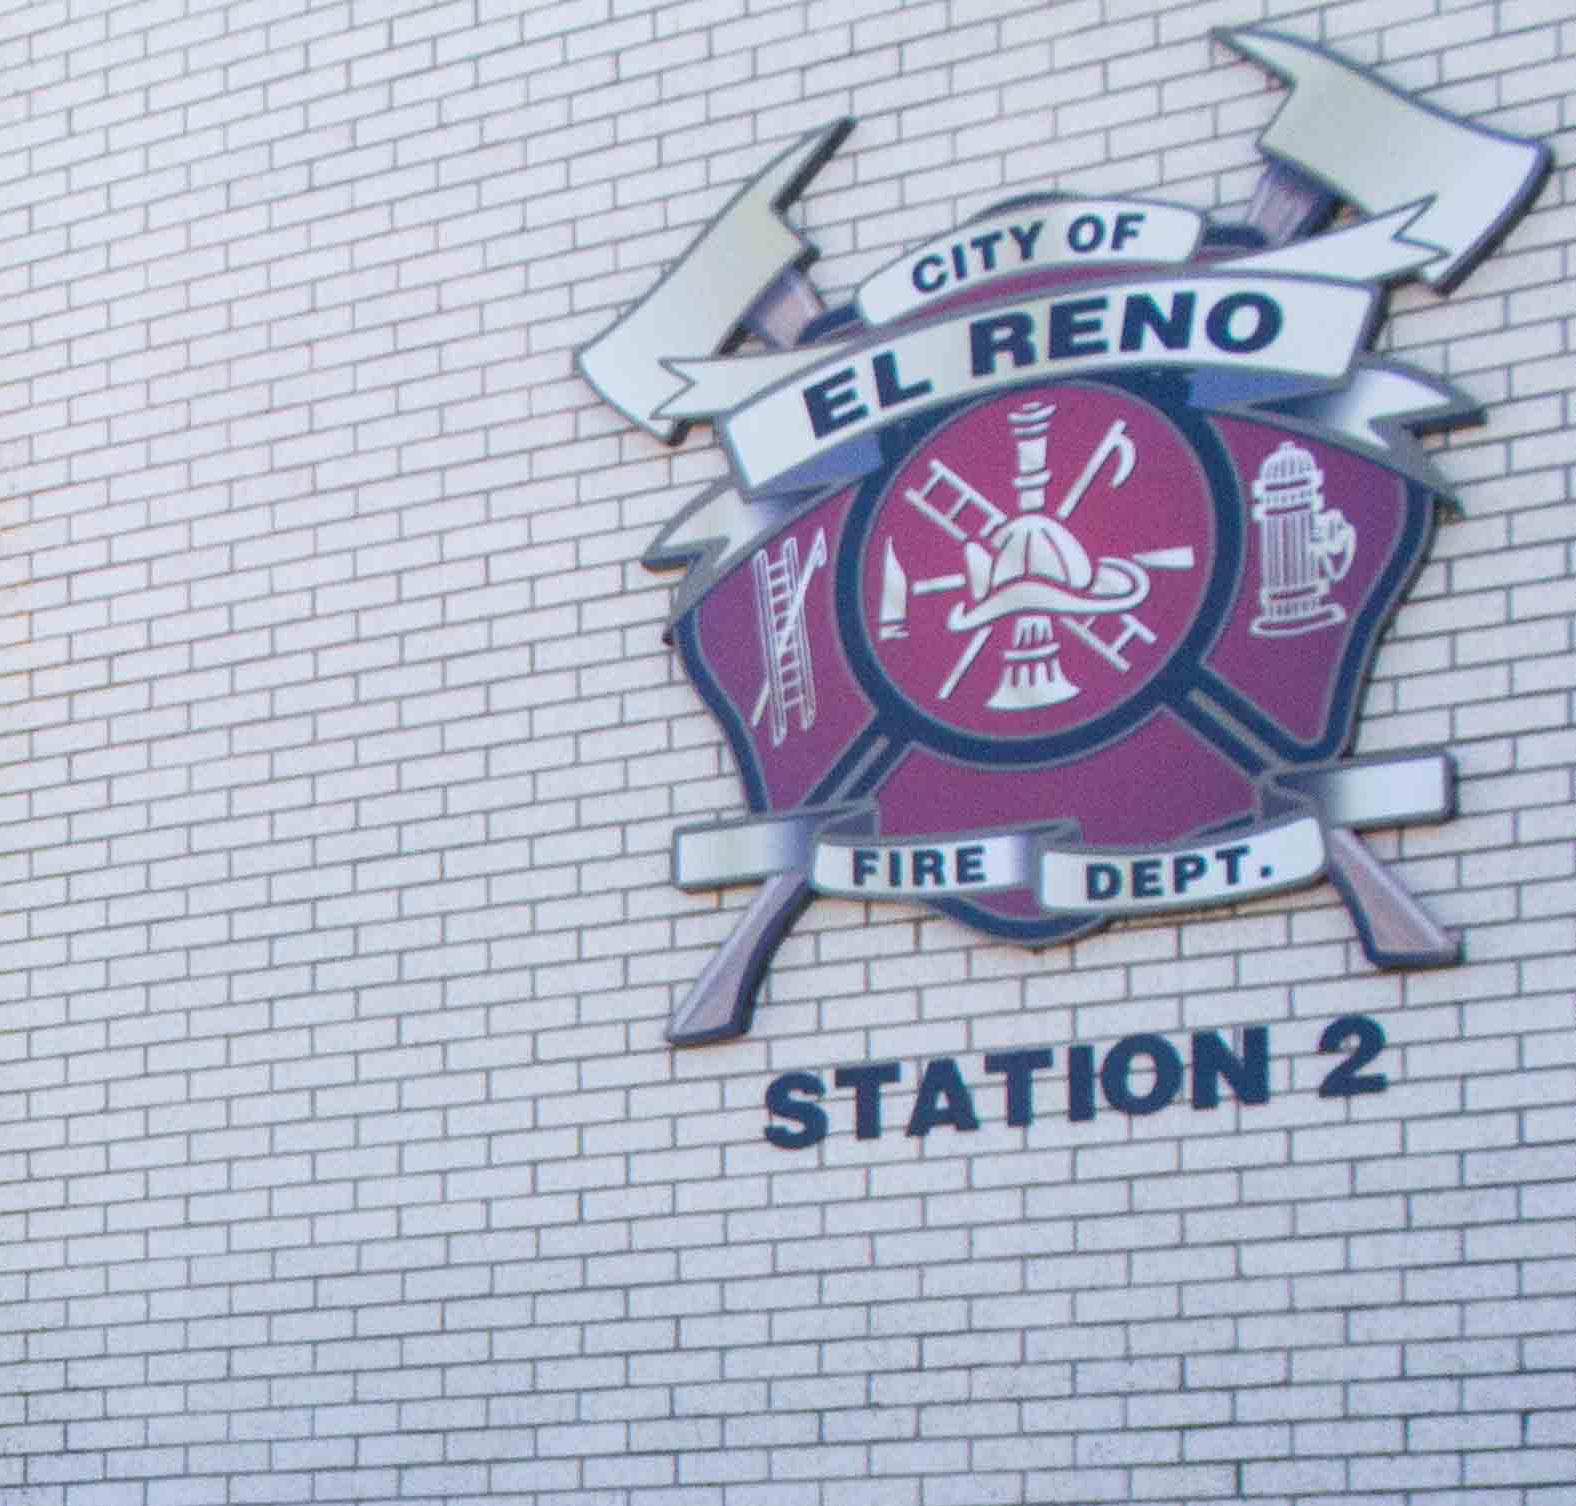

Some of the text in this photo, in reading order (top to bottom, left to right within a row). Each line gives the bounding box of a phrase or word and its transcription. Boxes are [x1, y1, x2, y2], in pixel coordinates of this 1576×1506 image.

[910, 212, 1147, 293] CITY OF
[801, 289, 1284, 441] EL RENO
[851, 844, 1274, 903] FIRE DEPT.
[763, 1014, 1390, 1151] STATION 2
